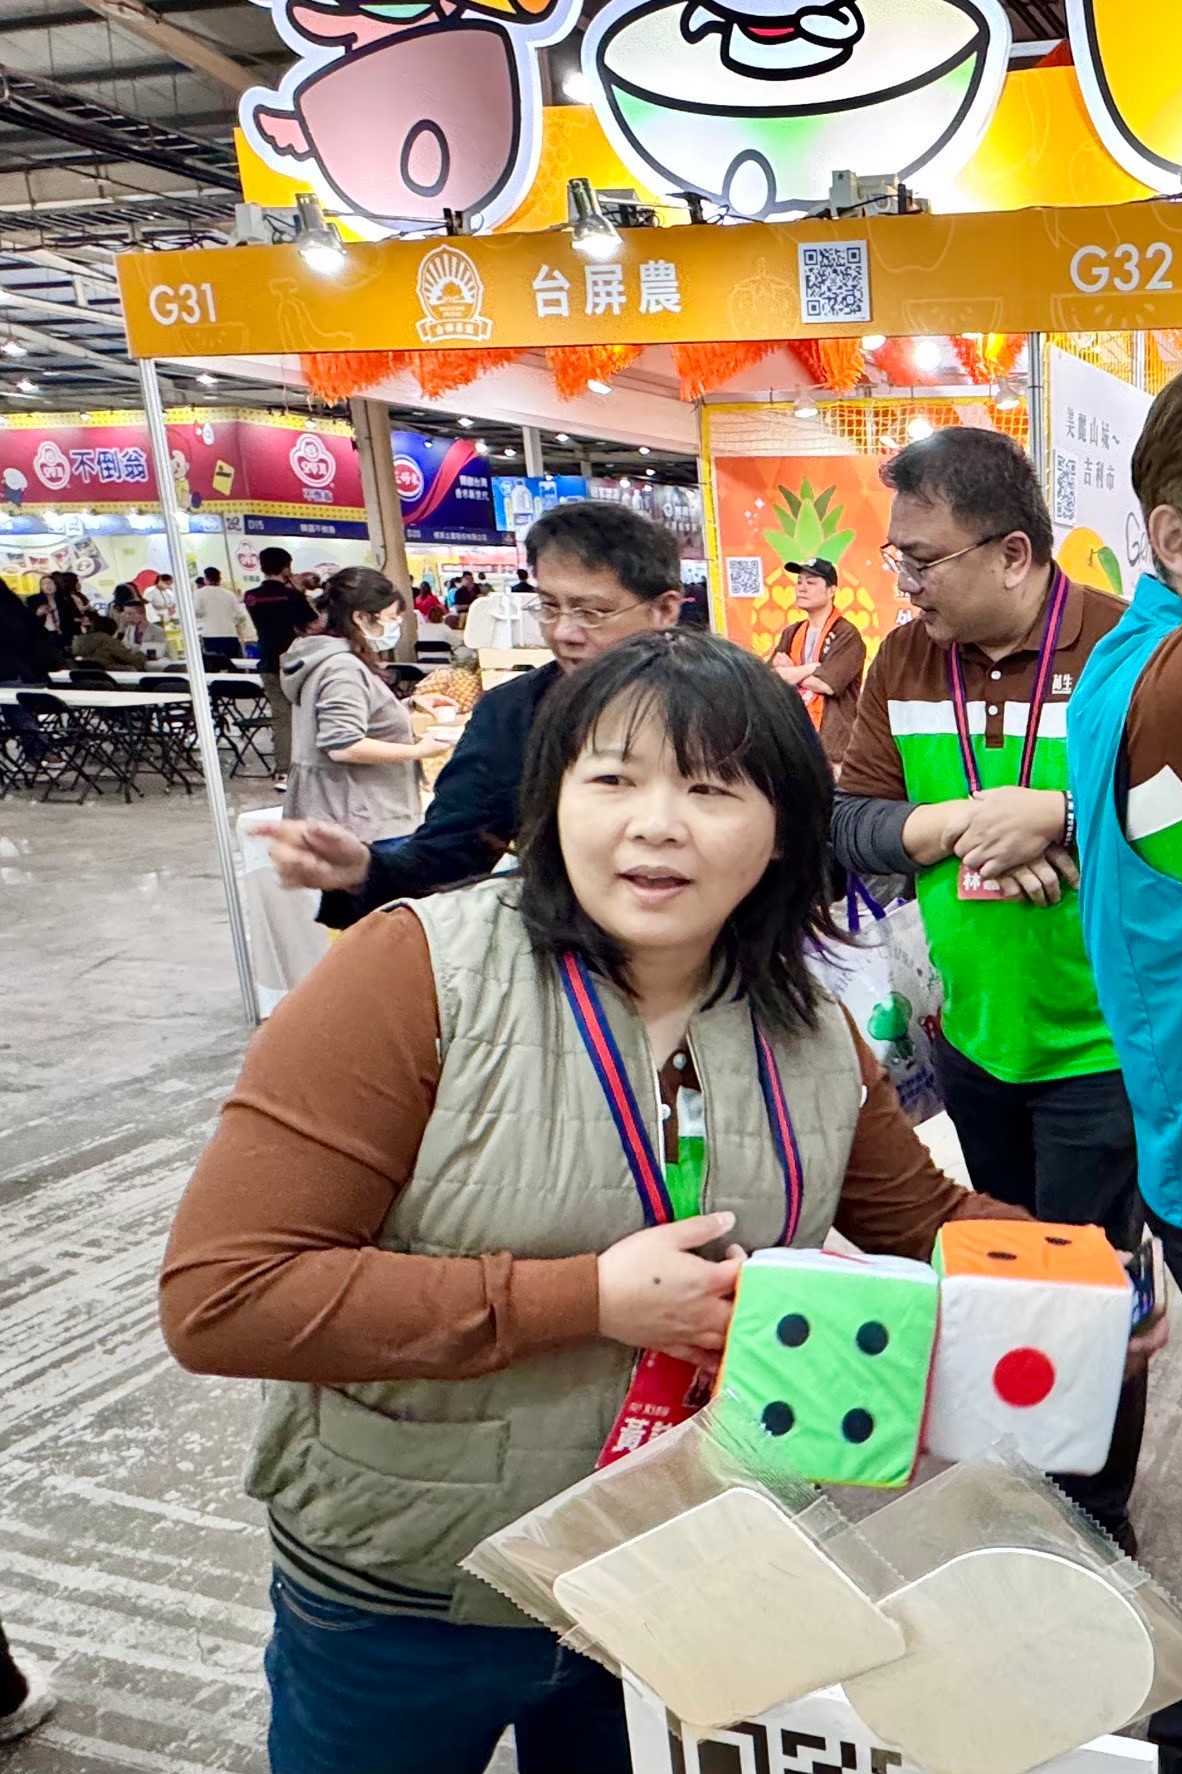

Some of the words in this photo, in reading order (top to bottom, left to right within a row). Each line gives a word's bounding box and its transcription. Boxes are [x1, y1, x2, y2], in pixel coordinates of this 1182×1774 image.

[532, 260, 682, 317] 台屏農
[1070, 241, 1173, 293] G32
[149, 283, 217, 326] G31
[70, 448, 149, 483] 不倒翁
